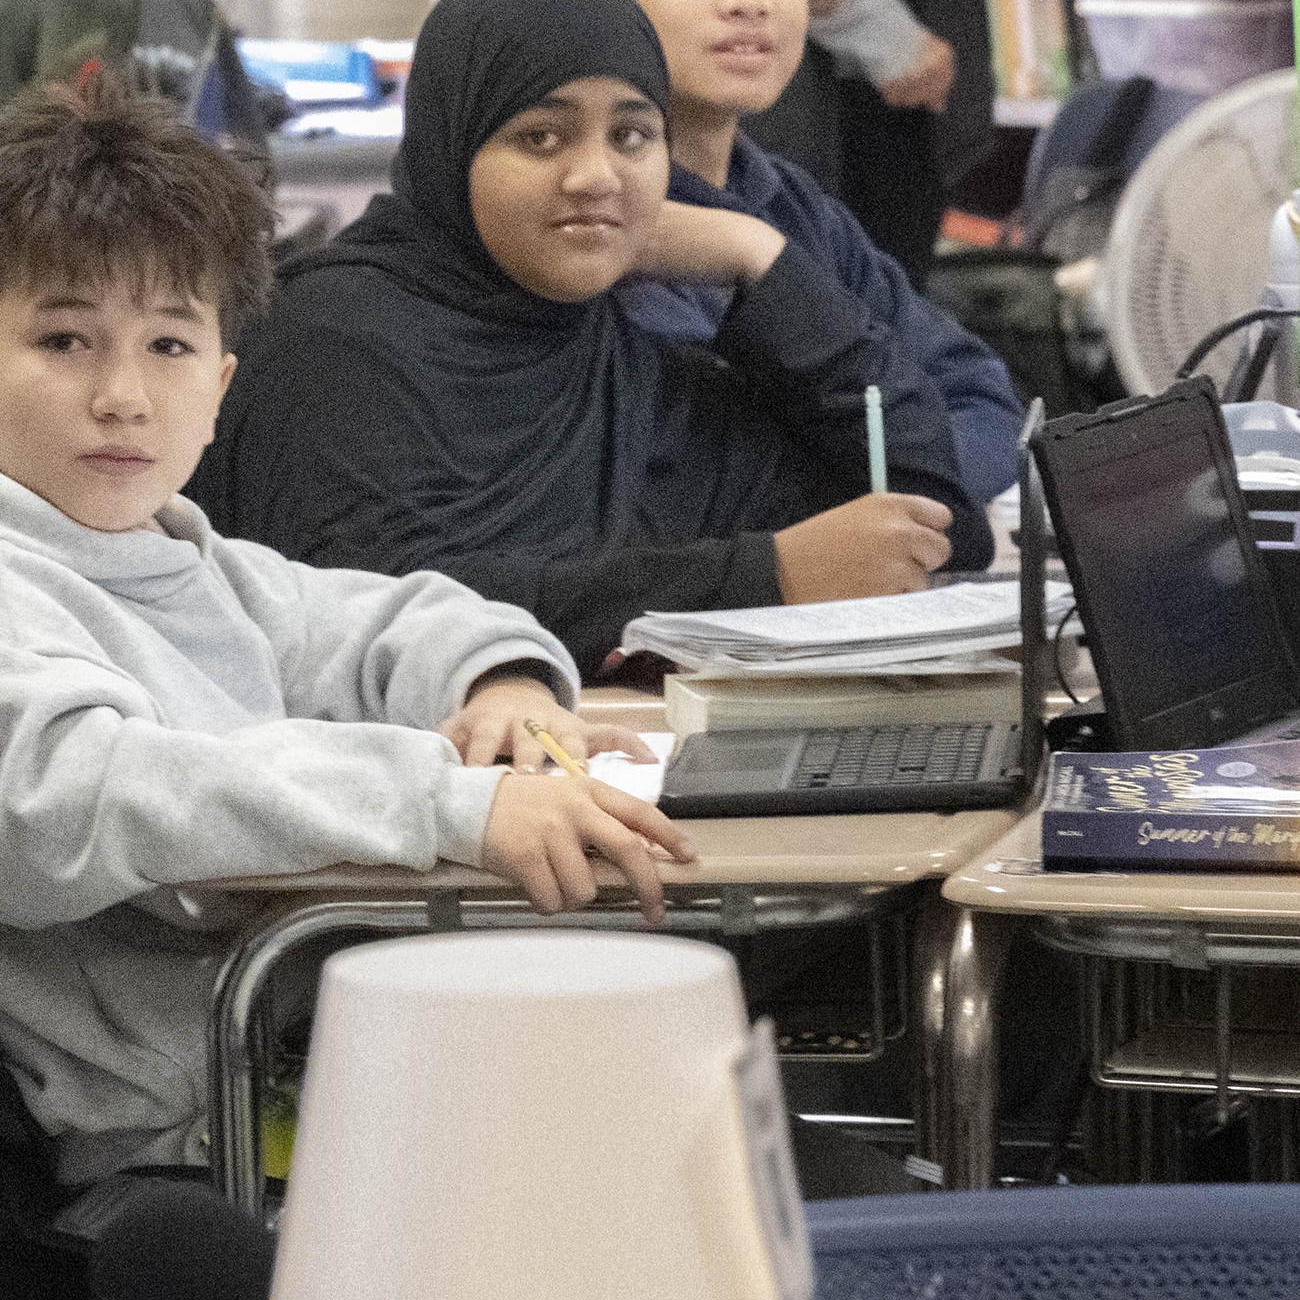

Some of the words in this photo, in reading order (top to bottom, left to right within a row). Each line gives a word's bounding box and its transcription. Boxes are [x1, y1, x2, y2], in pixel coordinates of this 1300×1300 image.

[1137, 820, 1211, 846] Summer
[1211, 825, 1227, 849] of
[1227, 825, 1250, 845] the
